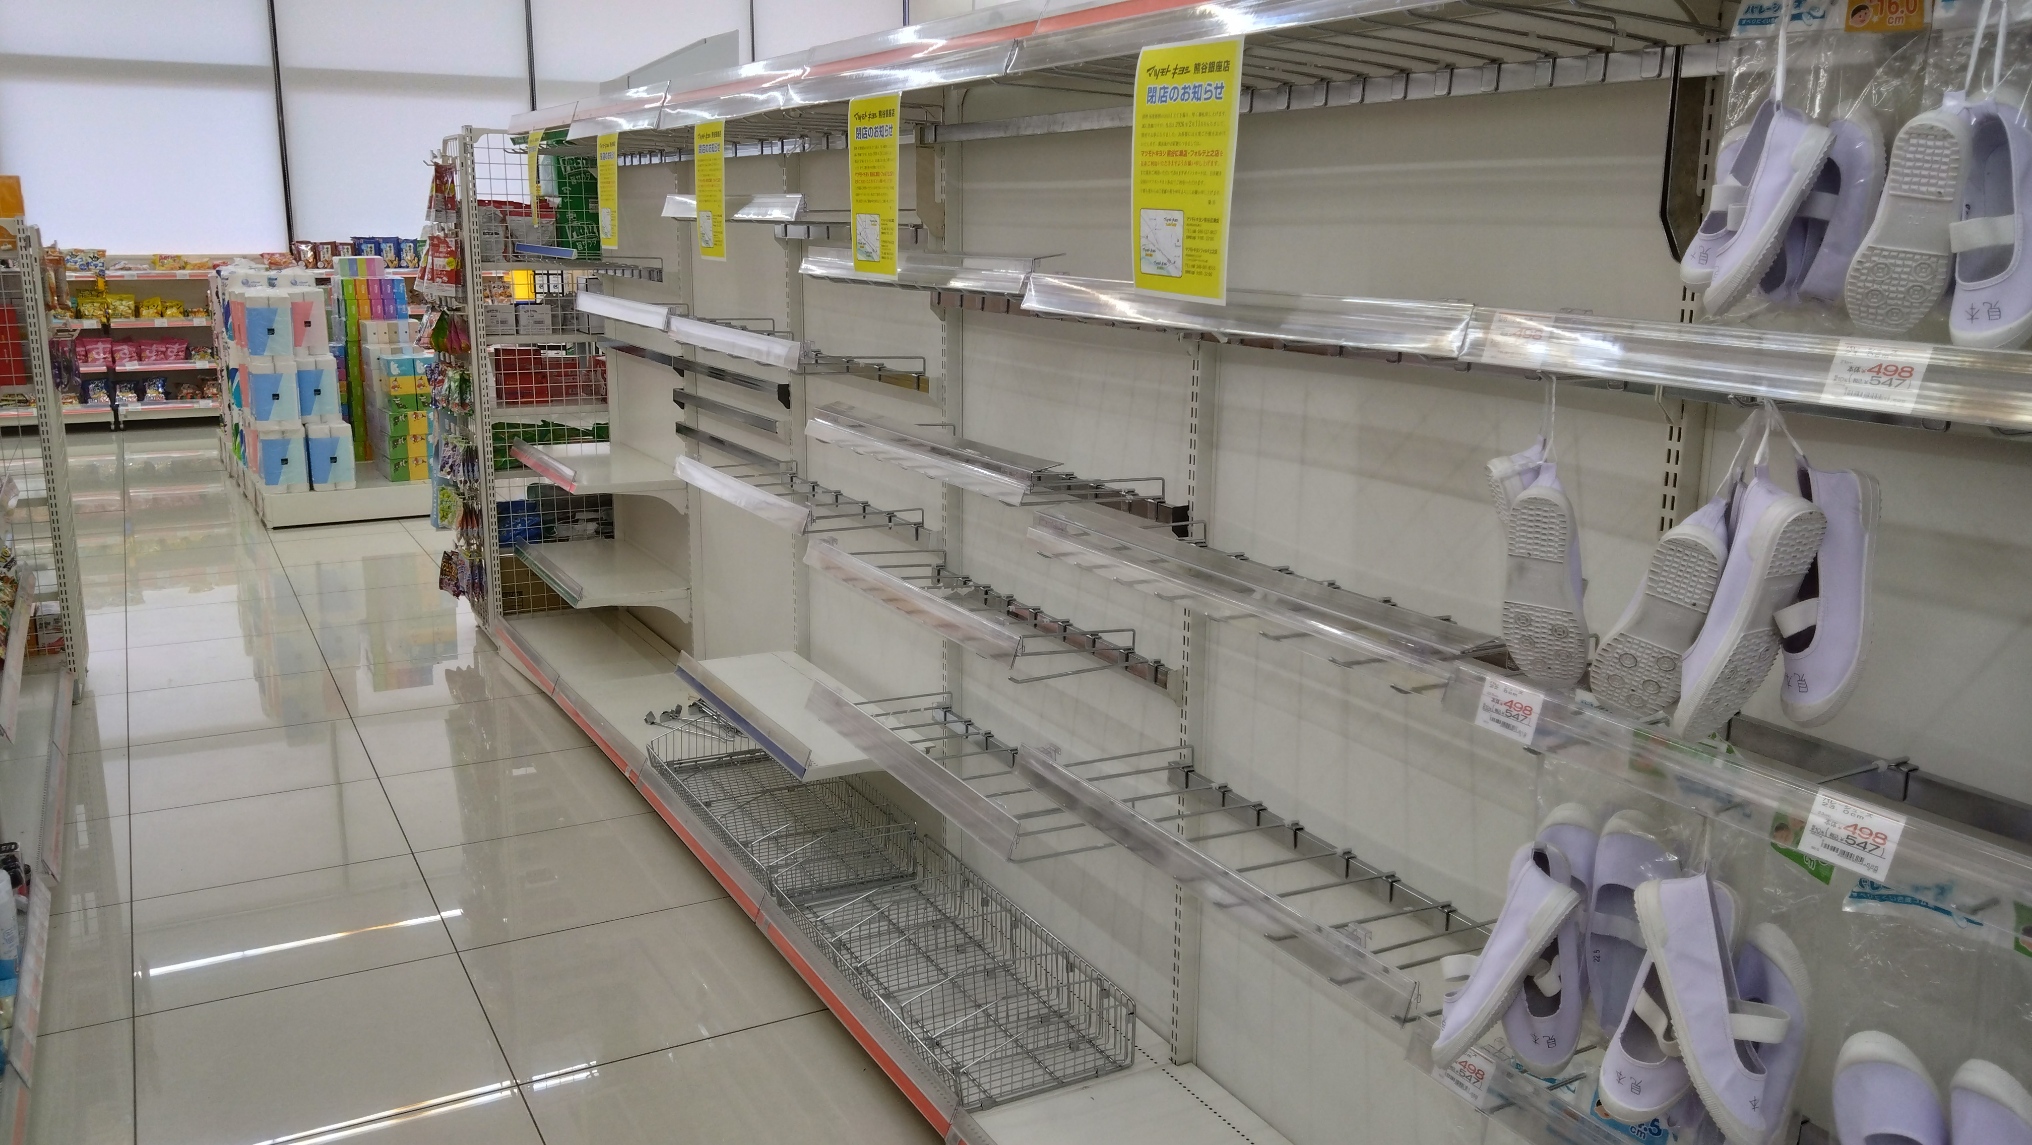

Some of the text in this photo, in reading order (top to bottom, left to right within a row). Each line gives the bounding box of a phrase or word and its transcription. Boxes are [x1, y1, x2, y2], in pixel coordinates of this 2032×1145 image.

[1887, 15, 1905, 26] cm
[1193, 60, 1231, 75] 熊谷銀座店
[1146, 81, 1225, 105] 閉店のお知らせ
[855, 124, 894, 140] 閉店のお知らせ
